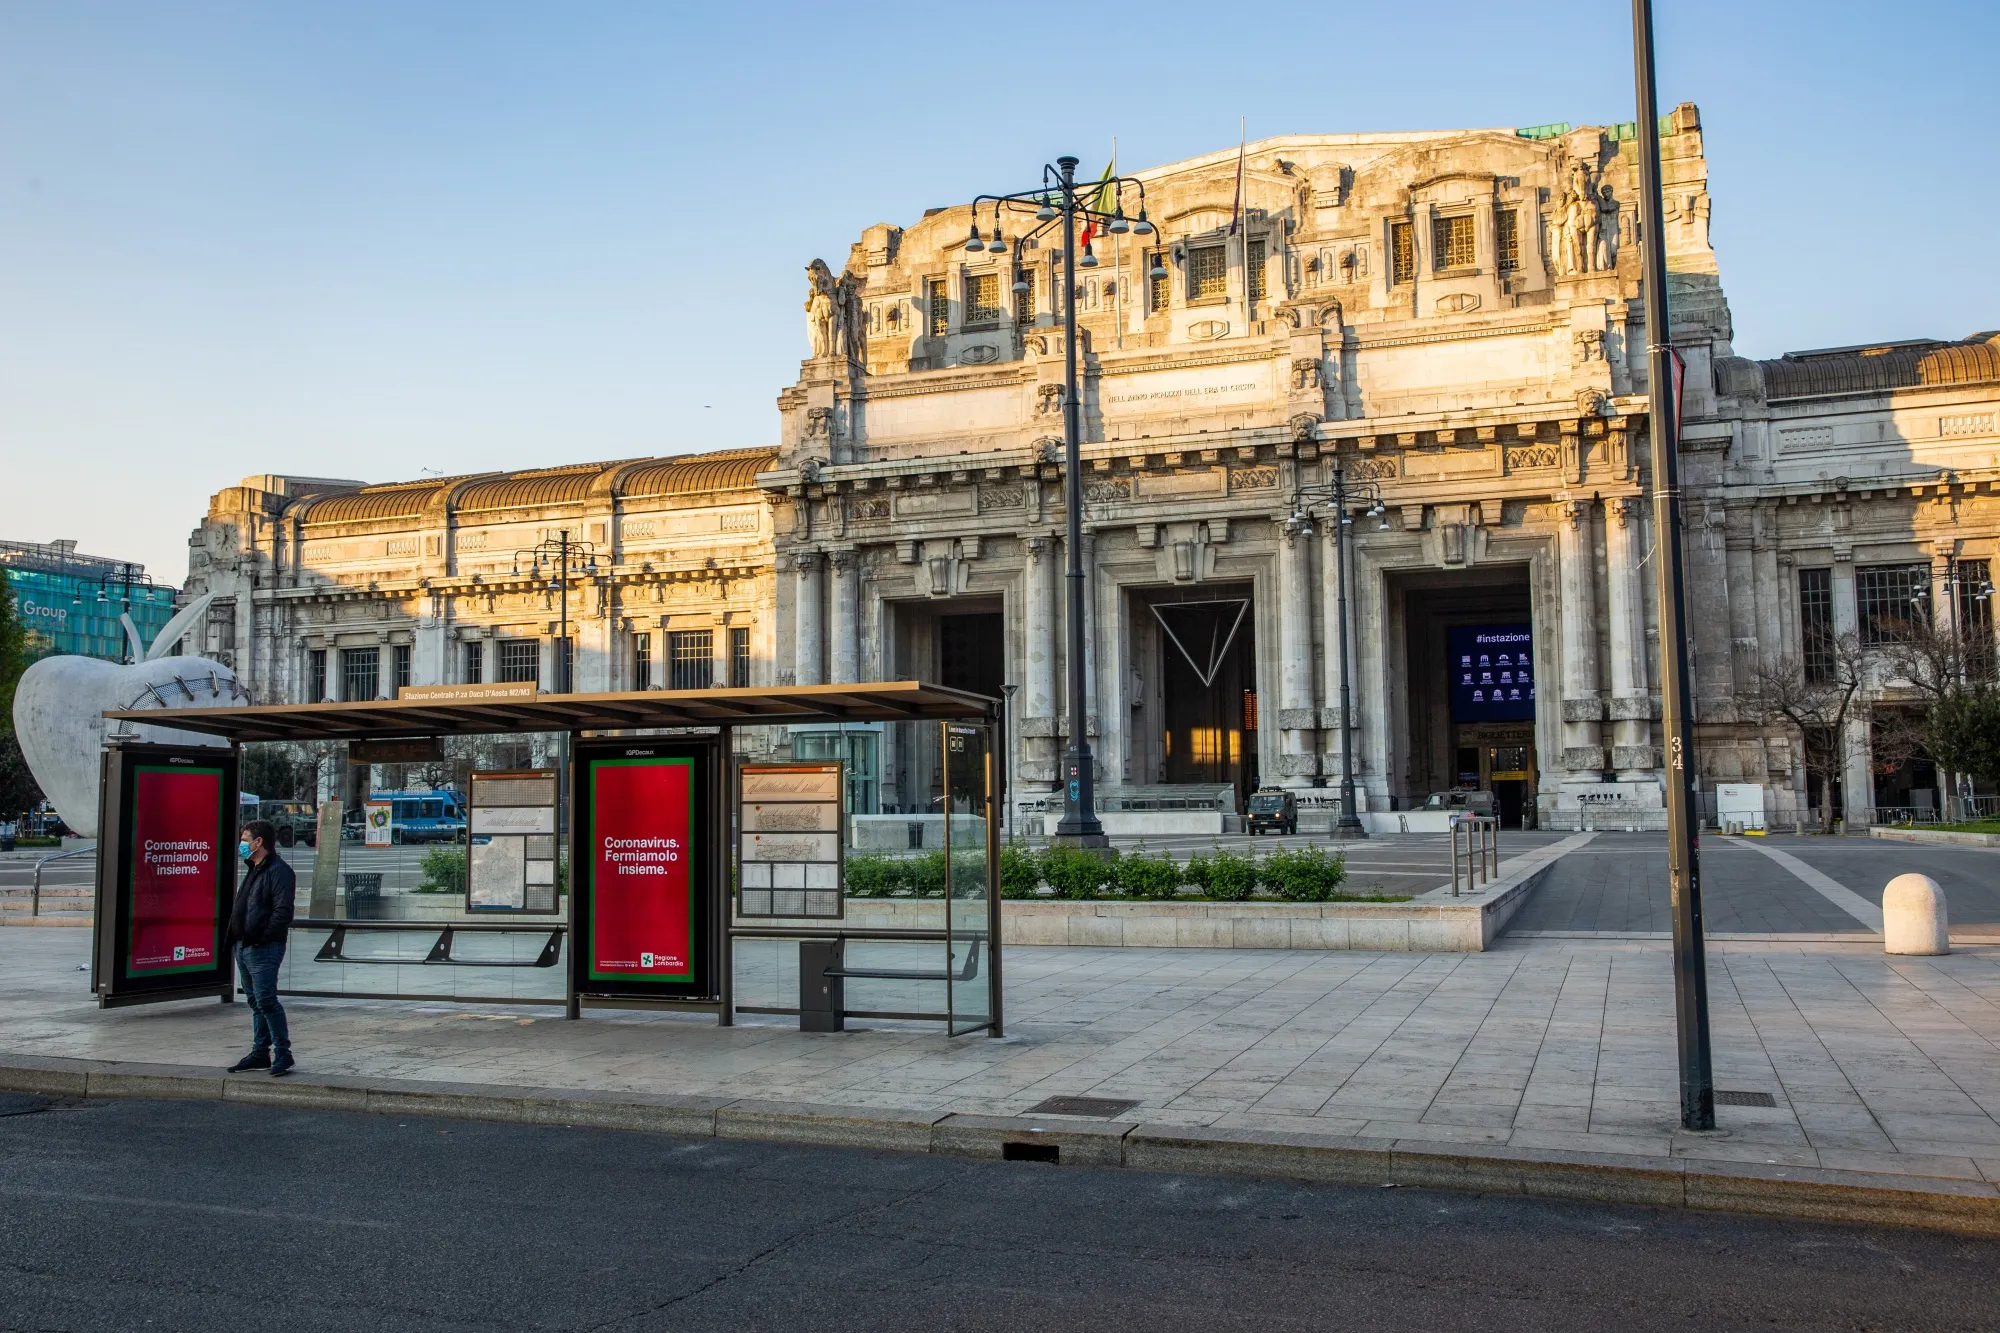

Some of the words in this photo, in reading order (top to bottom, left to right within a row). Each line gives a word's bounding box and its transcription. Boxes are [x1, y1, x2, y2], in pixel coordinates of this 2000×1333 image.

[23, 600, 67, 621] Group
[1476, 633, 1530, 643] #instazione
[404, 692, 430, 700] Stazione
[430, 691, 454, 699] Centrale
[468, 690, 484, 698] Duca
[485, 689, 508, 697] D'Aosta
[509, 688, 531, 696] M2/M3
[144, 839, 210, 851] Coronavirus.
[604, 836, 680, 848] Coronavirus.
[144, 851, 209, 864] Fermiamolo
[605, 850, 678, 862] Fermiamolo
[156, 864, 200, 876] insieme.
[618, 863, 668, 875] insieme.
